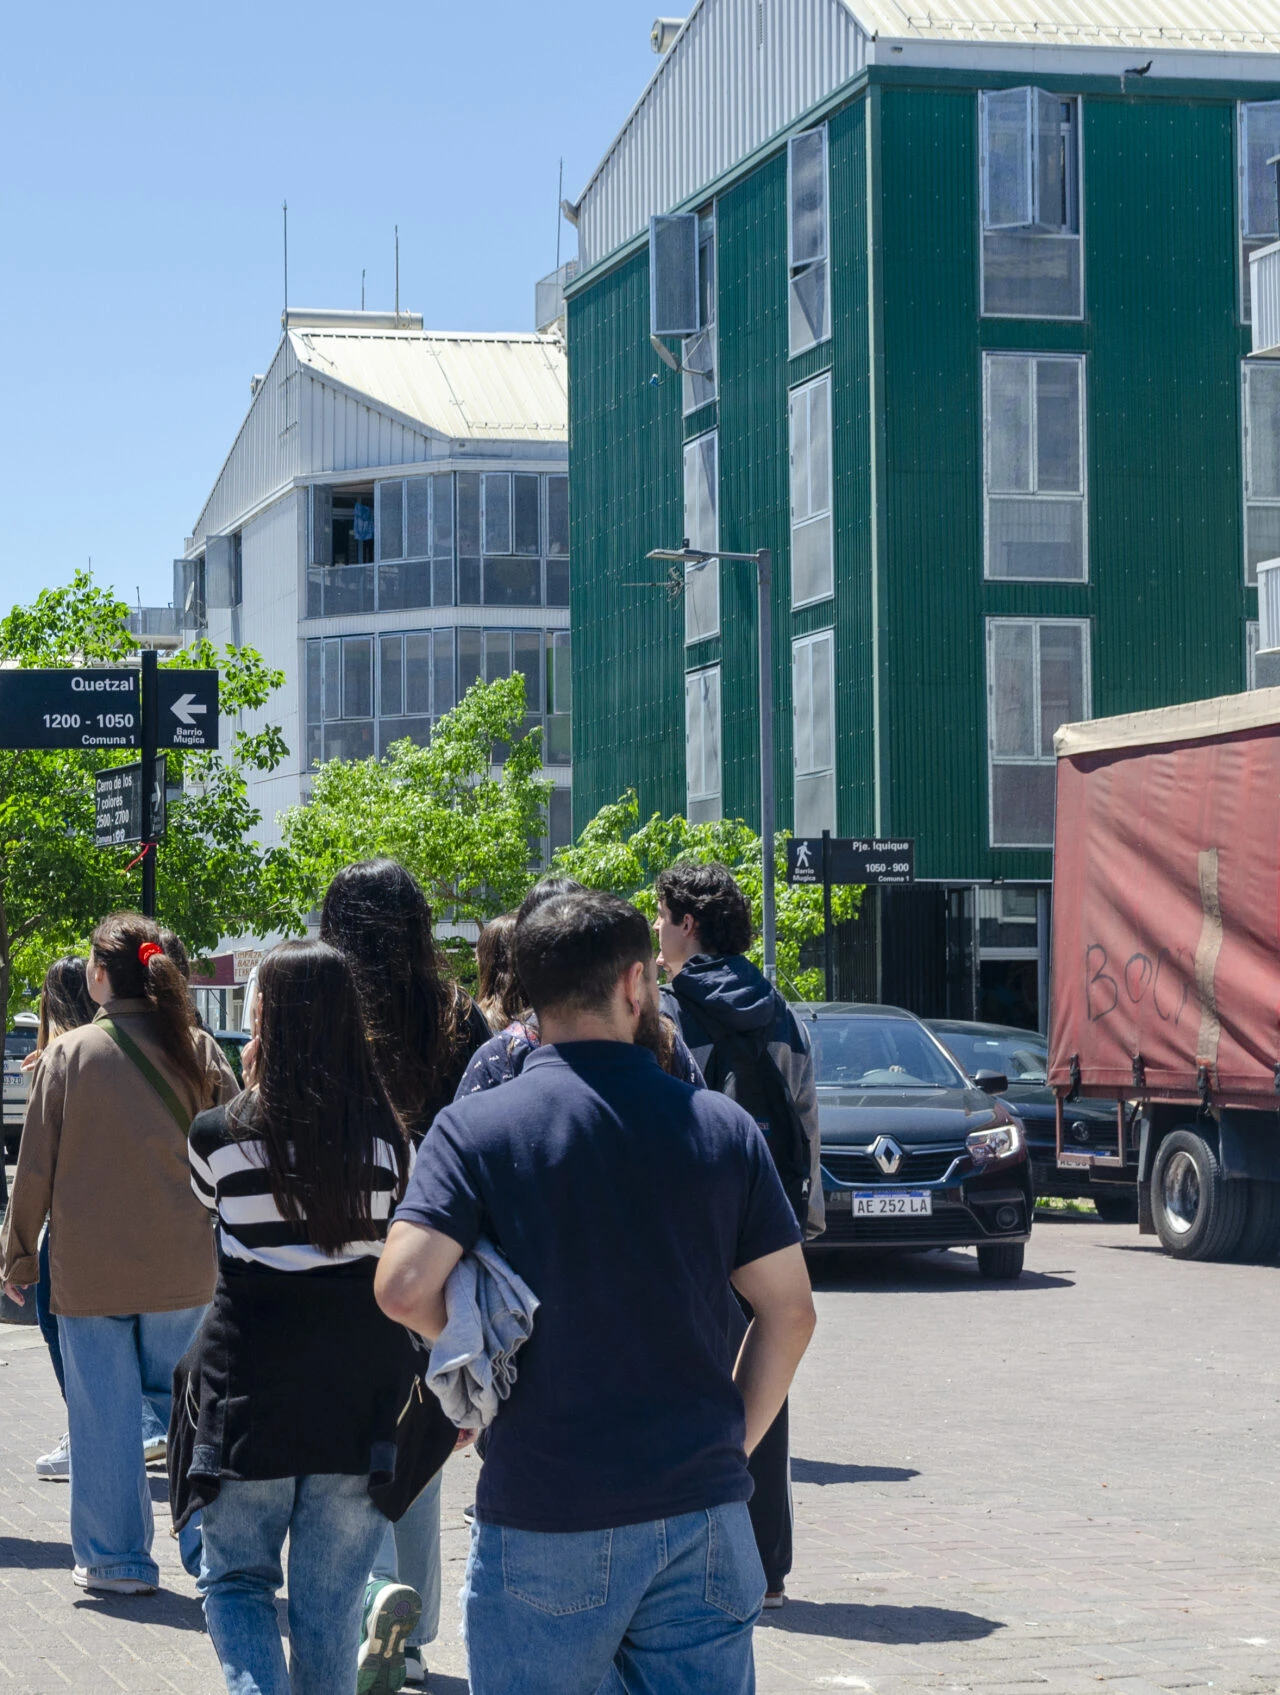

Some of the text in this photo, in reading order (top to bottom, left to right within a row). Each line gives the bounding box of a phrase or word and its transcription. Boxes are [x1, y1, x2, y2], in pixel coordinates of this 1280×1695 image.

[71, 676, 134, 692] Quetzal
[43, 714, 80, 728] 1200
[97, 714, 134, 728] 1050
[176, 727, 202, 736] Barrio
[82, 735, 134, 745] Comuna 1
[173, 735, 205, 745] Mugica
[96, 774, 132, 793] Cerro de los
[96, 795, 123, 811] 7 colores
[96, 813, 111, 829] 2500
[114, 809, 129, 825] 2700
[852, 841, 909, 852] Pje. Iquique
[794, 867, 815, 875] Barrio
[865, 863, 886, 873] 1050
[893, 863, 909, 872] 900
[878, 875, 904, 883] Comuna
[857, 1199, 928, 1214] AE 252 LA
